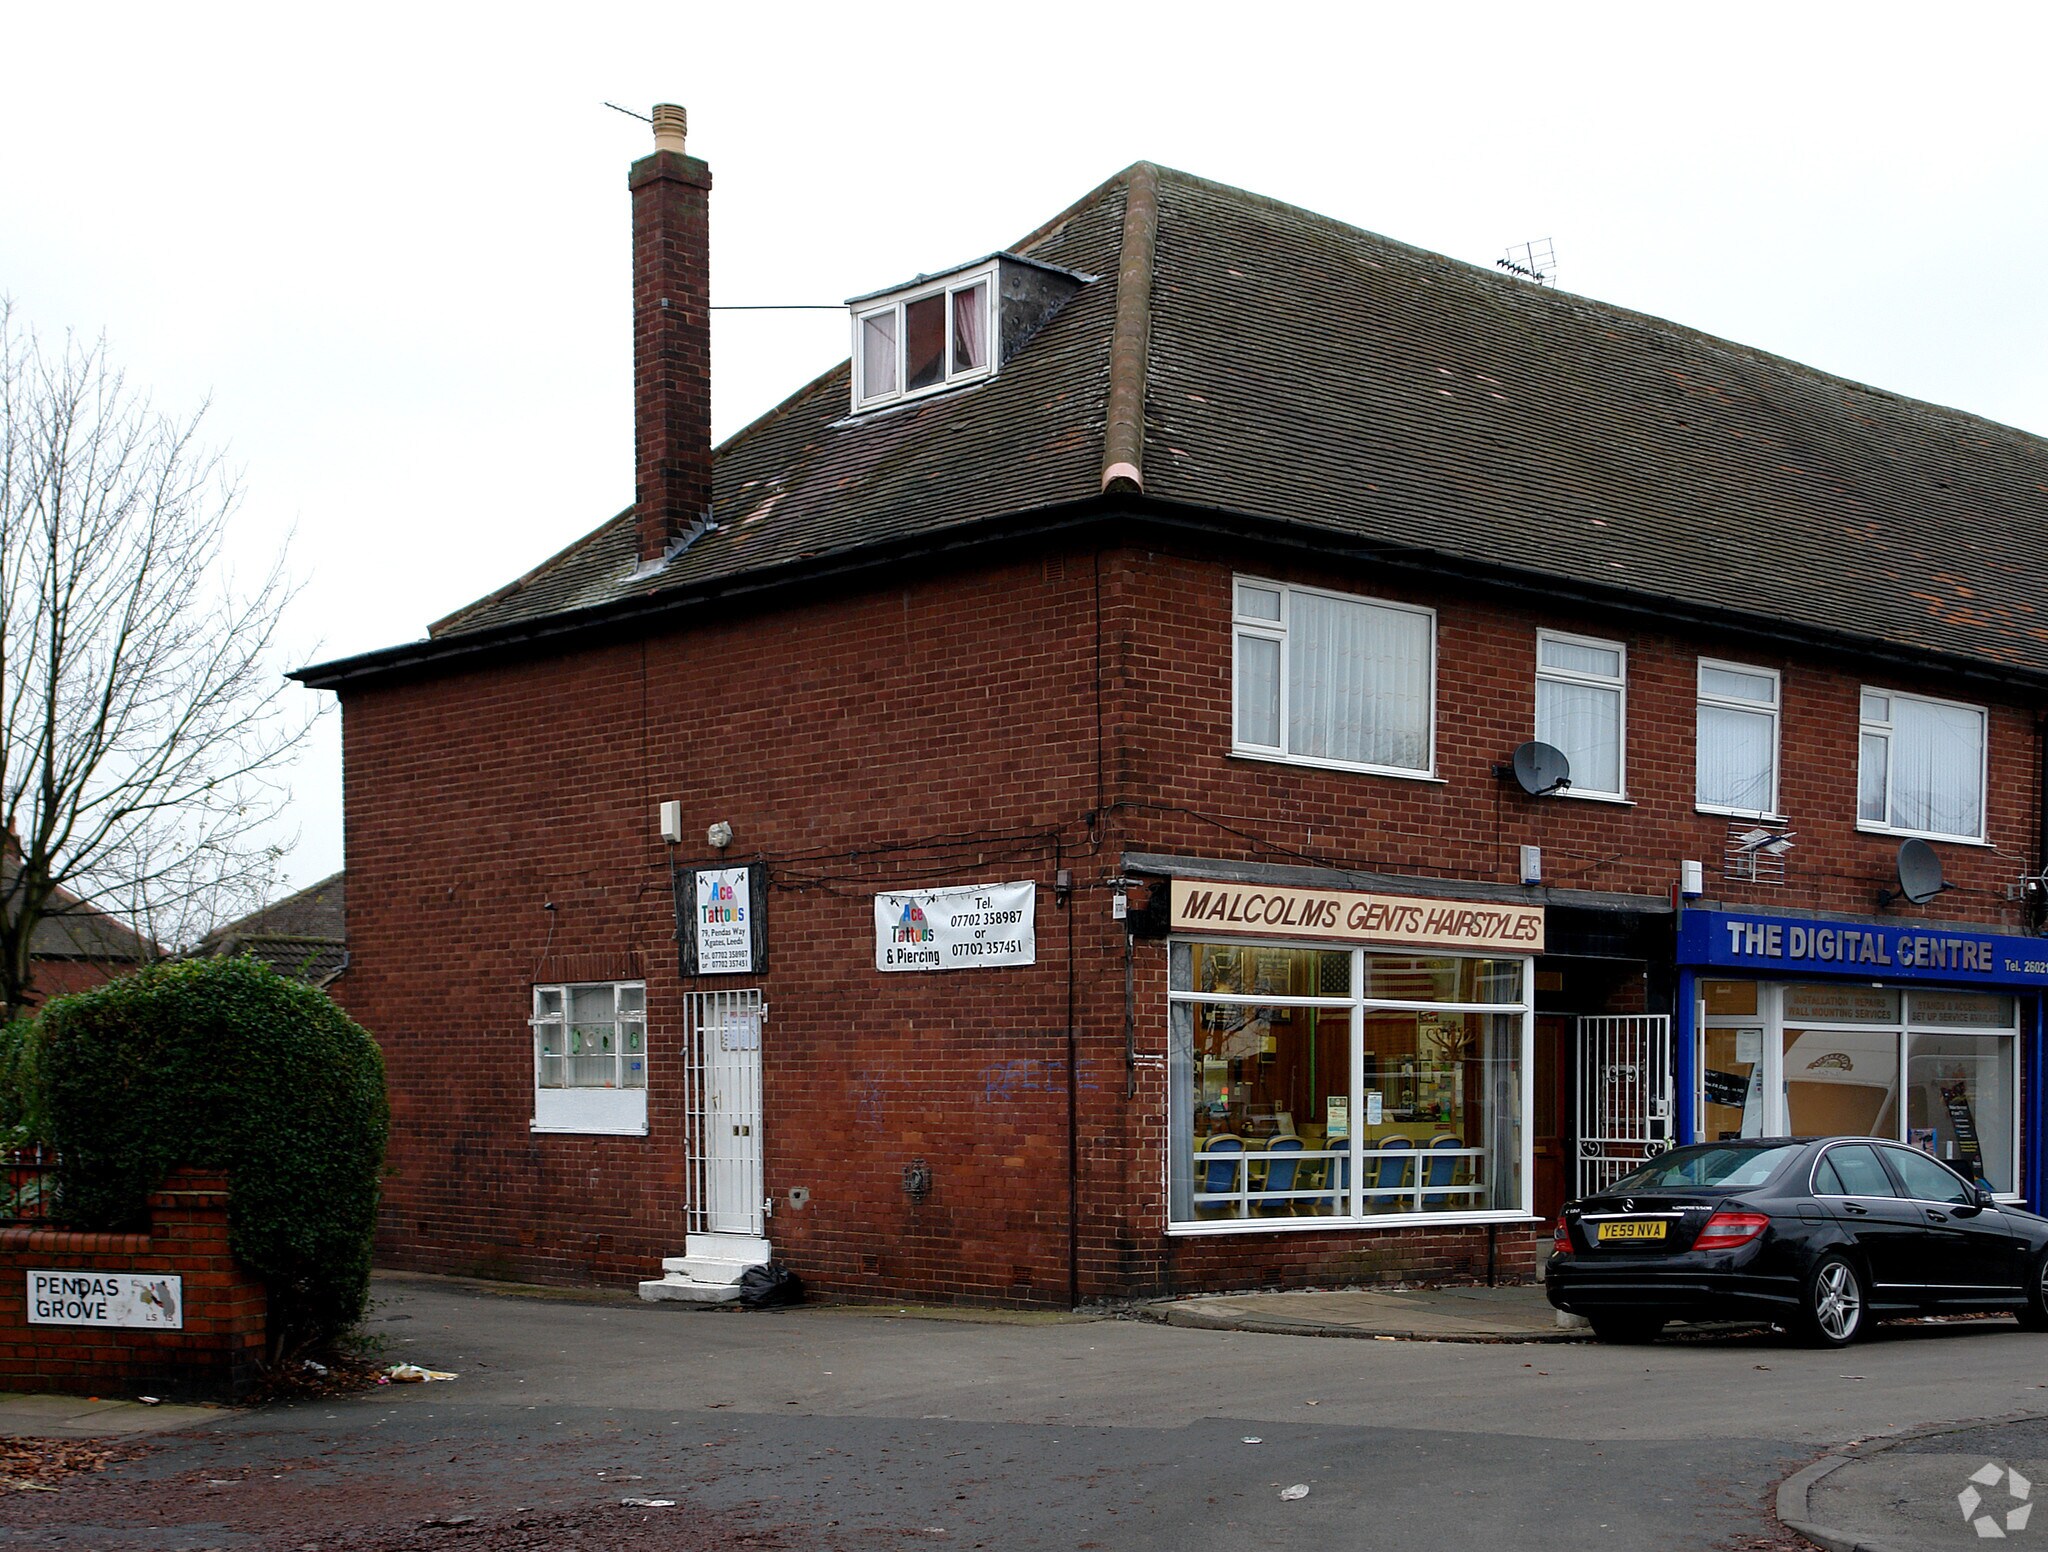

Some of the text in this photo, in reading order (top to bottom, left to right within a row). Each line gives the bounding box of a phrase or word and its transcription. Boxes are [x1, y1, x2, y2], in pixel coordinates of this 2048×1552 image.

[712, 882, 733, 901] Ace
[975, 897, 993, 909] Tel.
[702, 905, 744, 923] Tattoos
[902, 904, 924, 922] Ace
[951, 911, 1022, 927] 07702 358987
[1182, 890, 1541, 941] MALCOLMS GENTS HAIRSTYLES
[701, 928, 745, 937] 79, Pendas Way
[892, 926, 934, 943] Tattoos
[975, 930, 986, 938] or
[726, 938, 743, 946] Leeds
[952, 940, 1022, 956] 07702 357451
[1726, 921, 1992, 971] THE DIGITAL CENTRE
[887, 947, 940, 965] & Piercing
[2005, 959, 2021, 971] Tel.
[1788, 1008, 1891, 1019] WALL MOUNTING SERVICES
[1939, 1012, 1968, 1022] SERVICE
[1604, 1224, 1661, 1237] YE59 NVA
[36, 1276, 119, 1297] PENDAS
[36, 1301, 107, 1320] GROVE
[146, 1313, 157, 1321] LS
